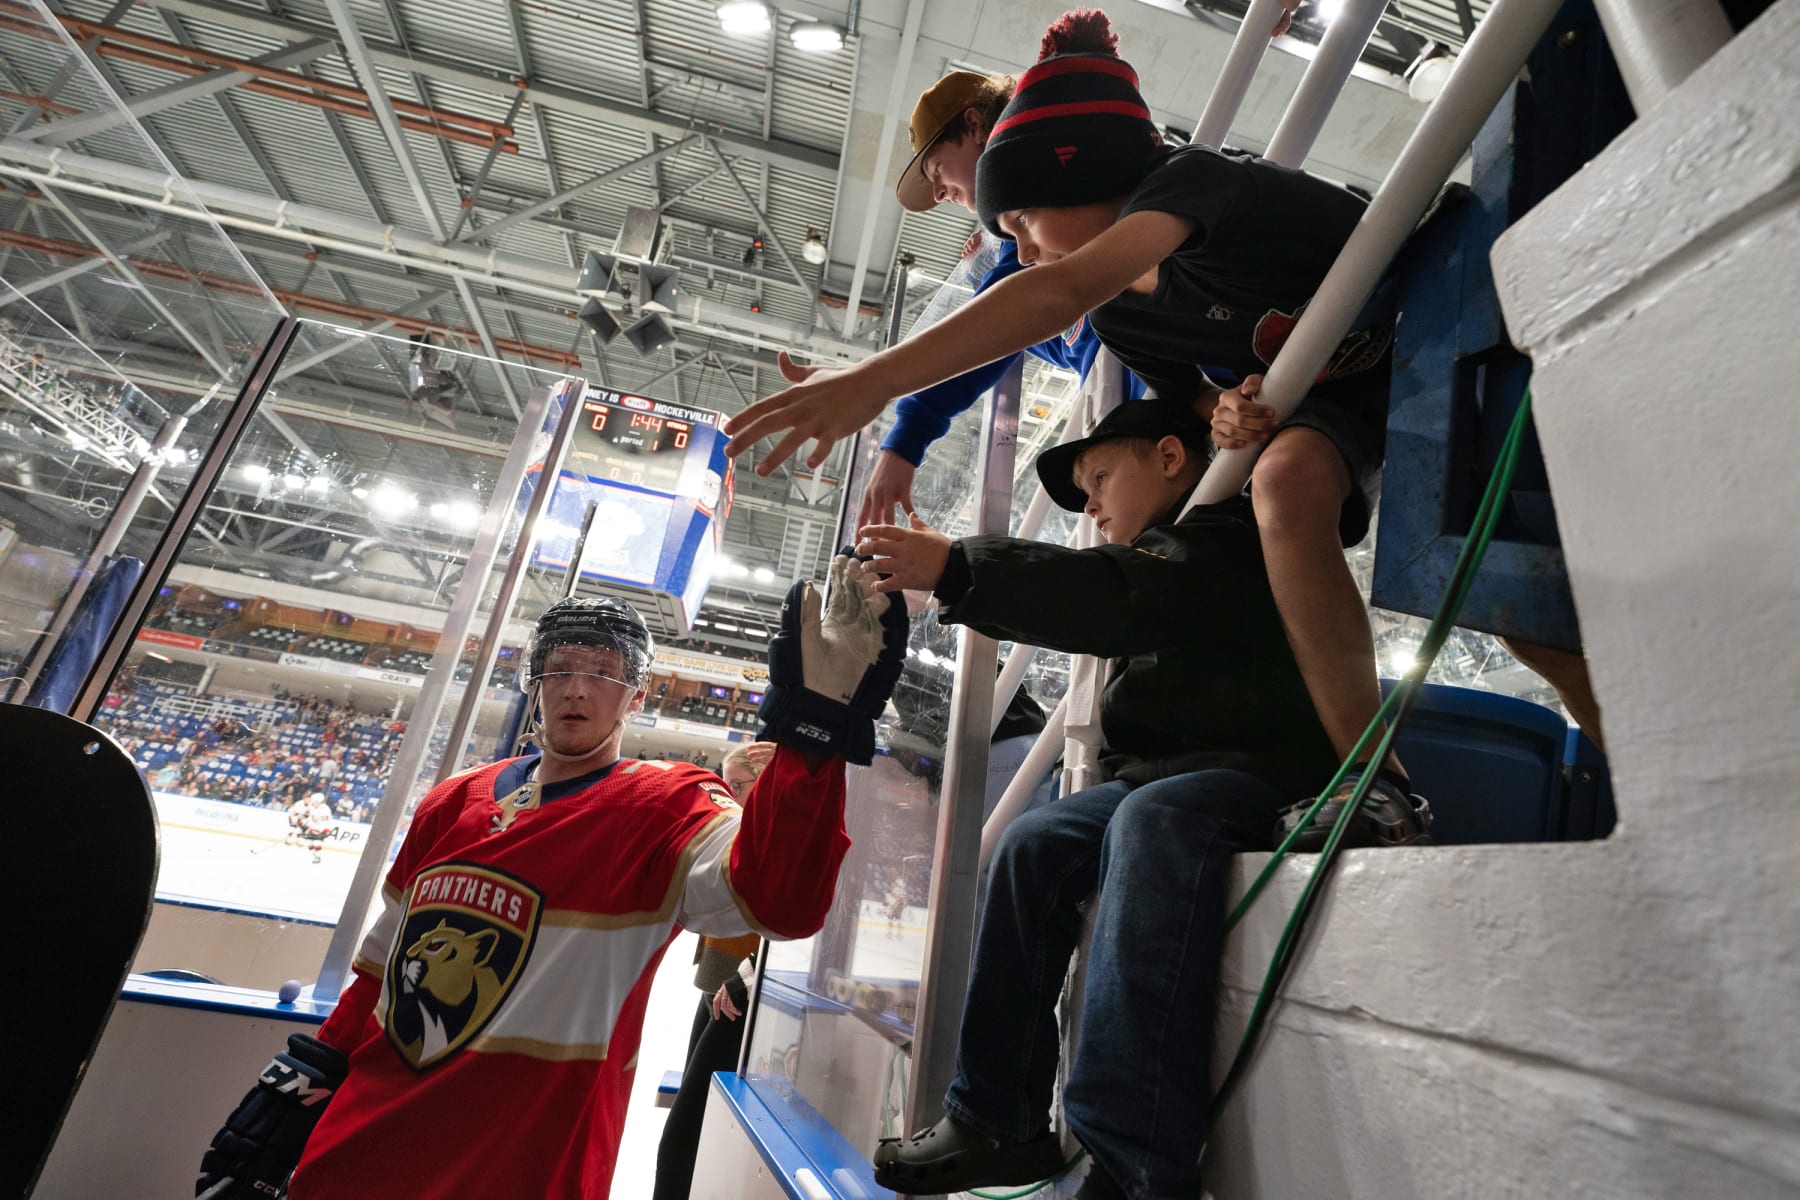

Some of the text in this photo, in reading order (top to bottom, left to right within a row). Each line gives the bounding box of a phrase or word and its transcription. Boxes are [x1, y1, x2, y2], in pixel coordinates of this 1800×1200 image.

[609, 392, 620, 403] IS
[626, 399, 648, 408] Kraft
[654, 402, 715, 425] HOCKEYVILLE
[592, 414, 606, 431] 0
[630, 413, 663, 433] 1:44
[620, 435, 659, 452] period 1
[674, 432, 688, 449] 0
[609, 467, 620, 479] 0
[707, 661, 727, 671] LIVE
[728, 665, 740, 674] ON
[416, 875, 523, 922] PANTHERS
